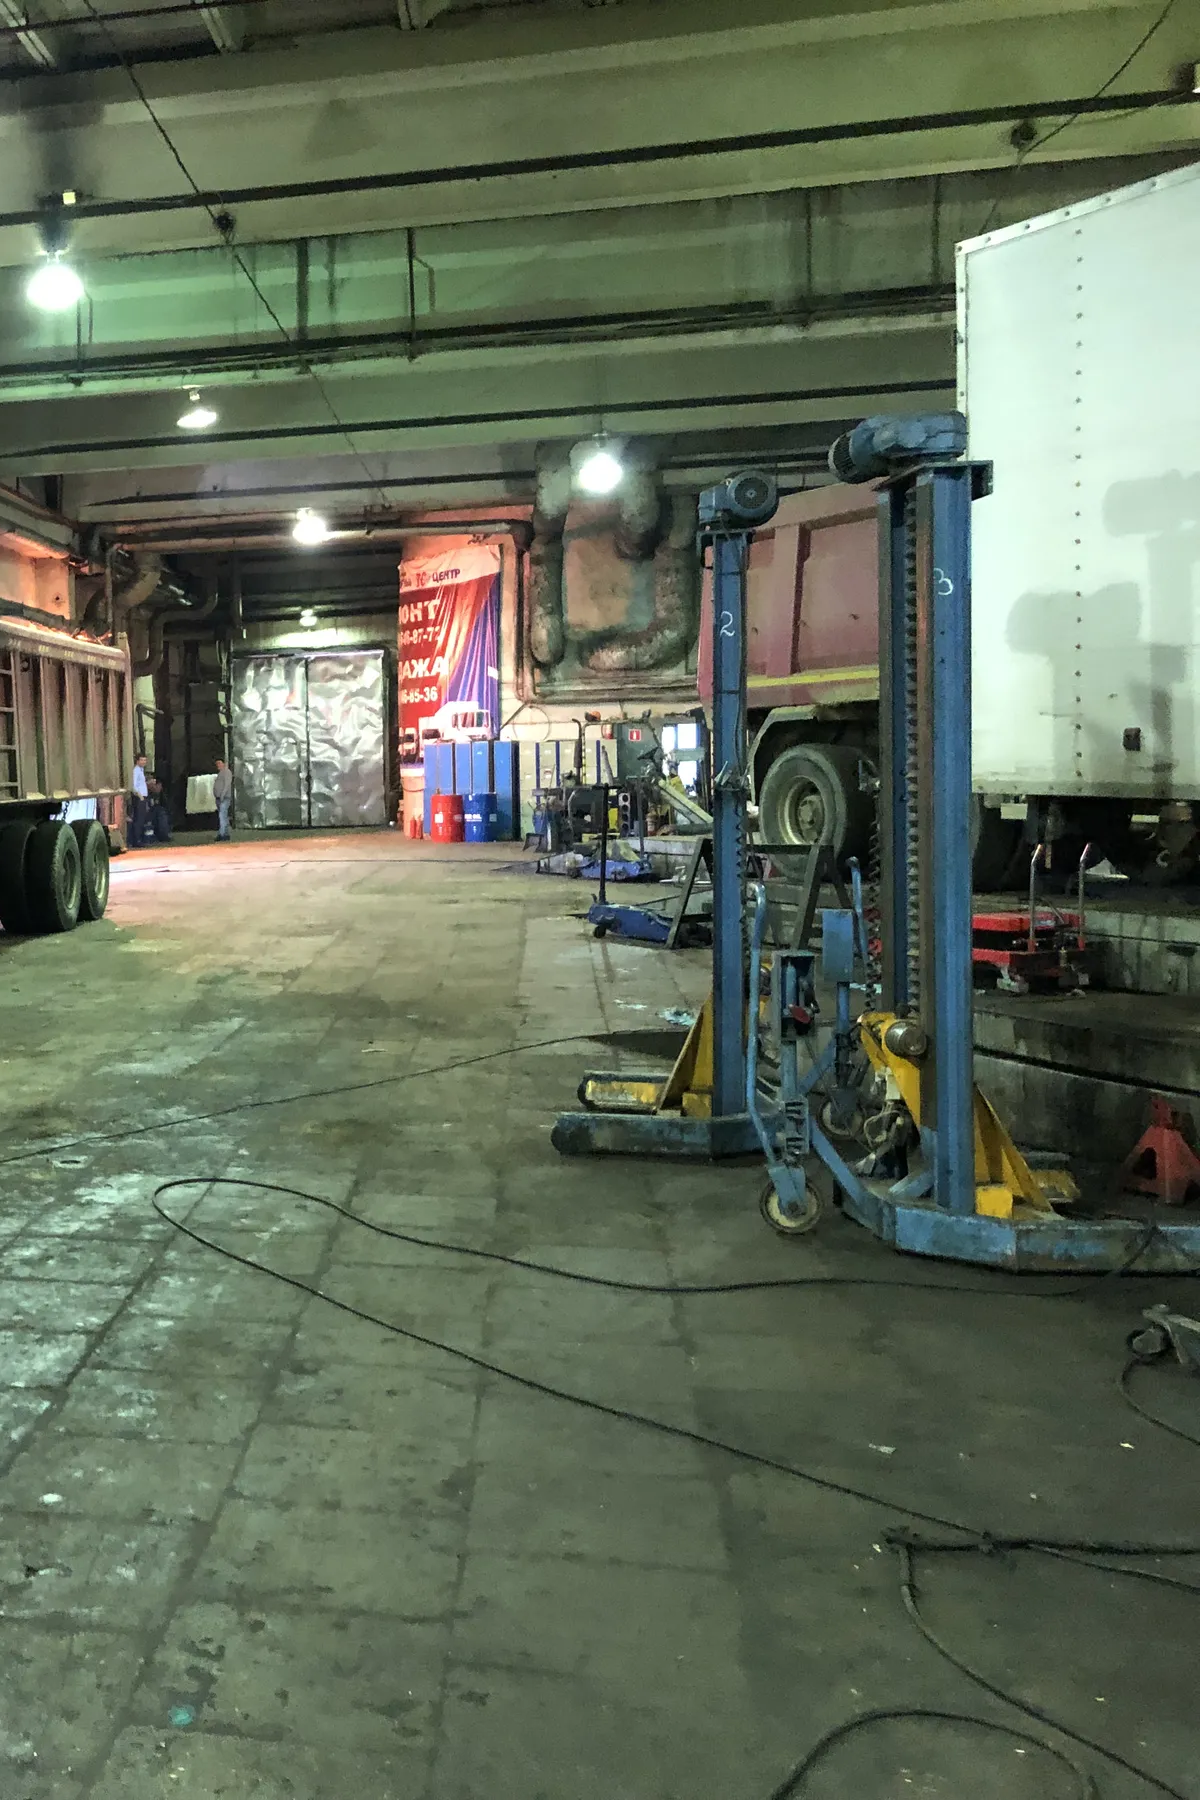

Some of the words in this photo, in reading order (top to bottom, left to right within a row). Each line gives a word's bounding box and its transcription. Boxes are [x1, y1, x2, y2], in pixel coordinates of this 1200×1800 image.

[432, 568, 461, 583] ЦЕНТР
[933, 567, 953, 596] 3
[399, 599, 440, 624] ОНТ
[720, 611, 735, 636] 2
